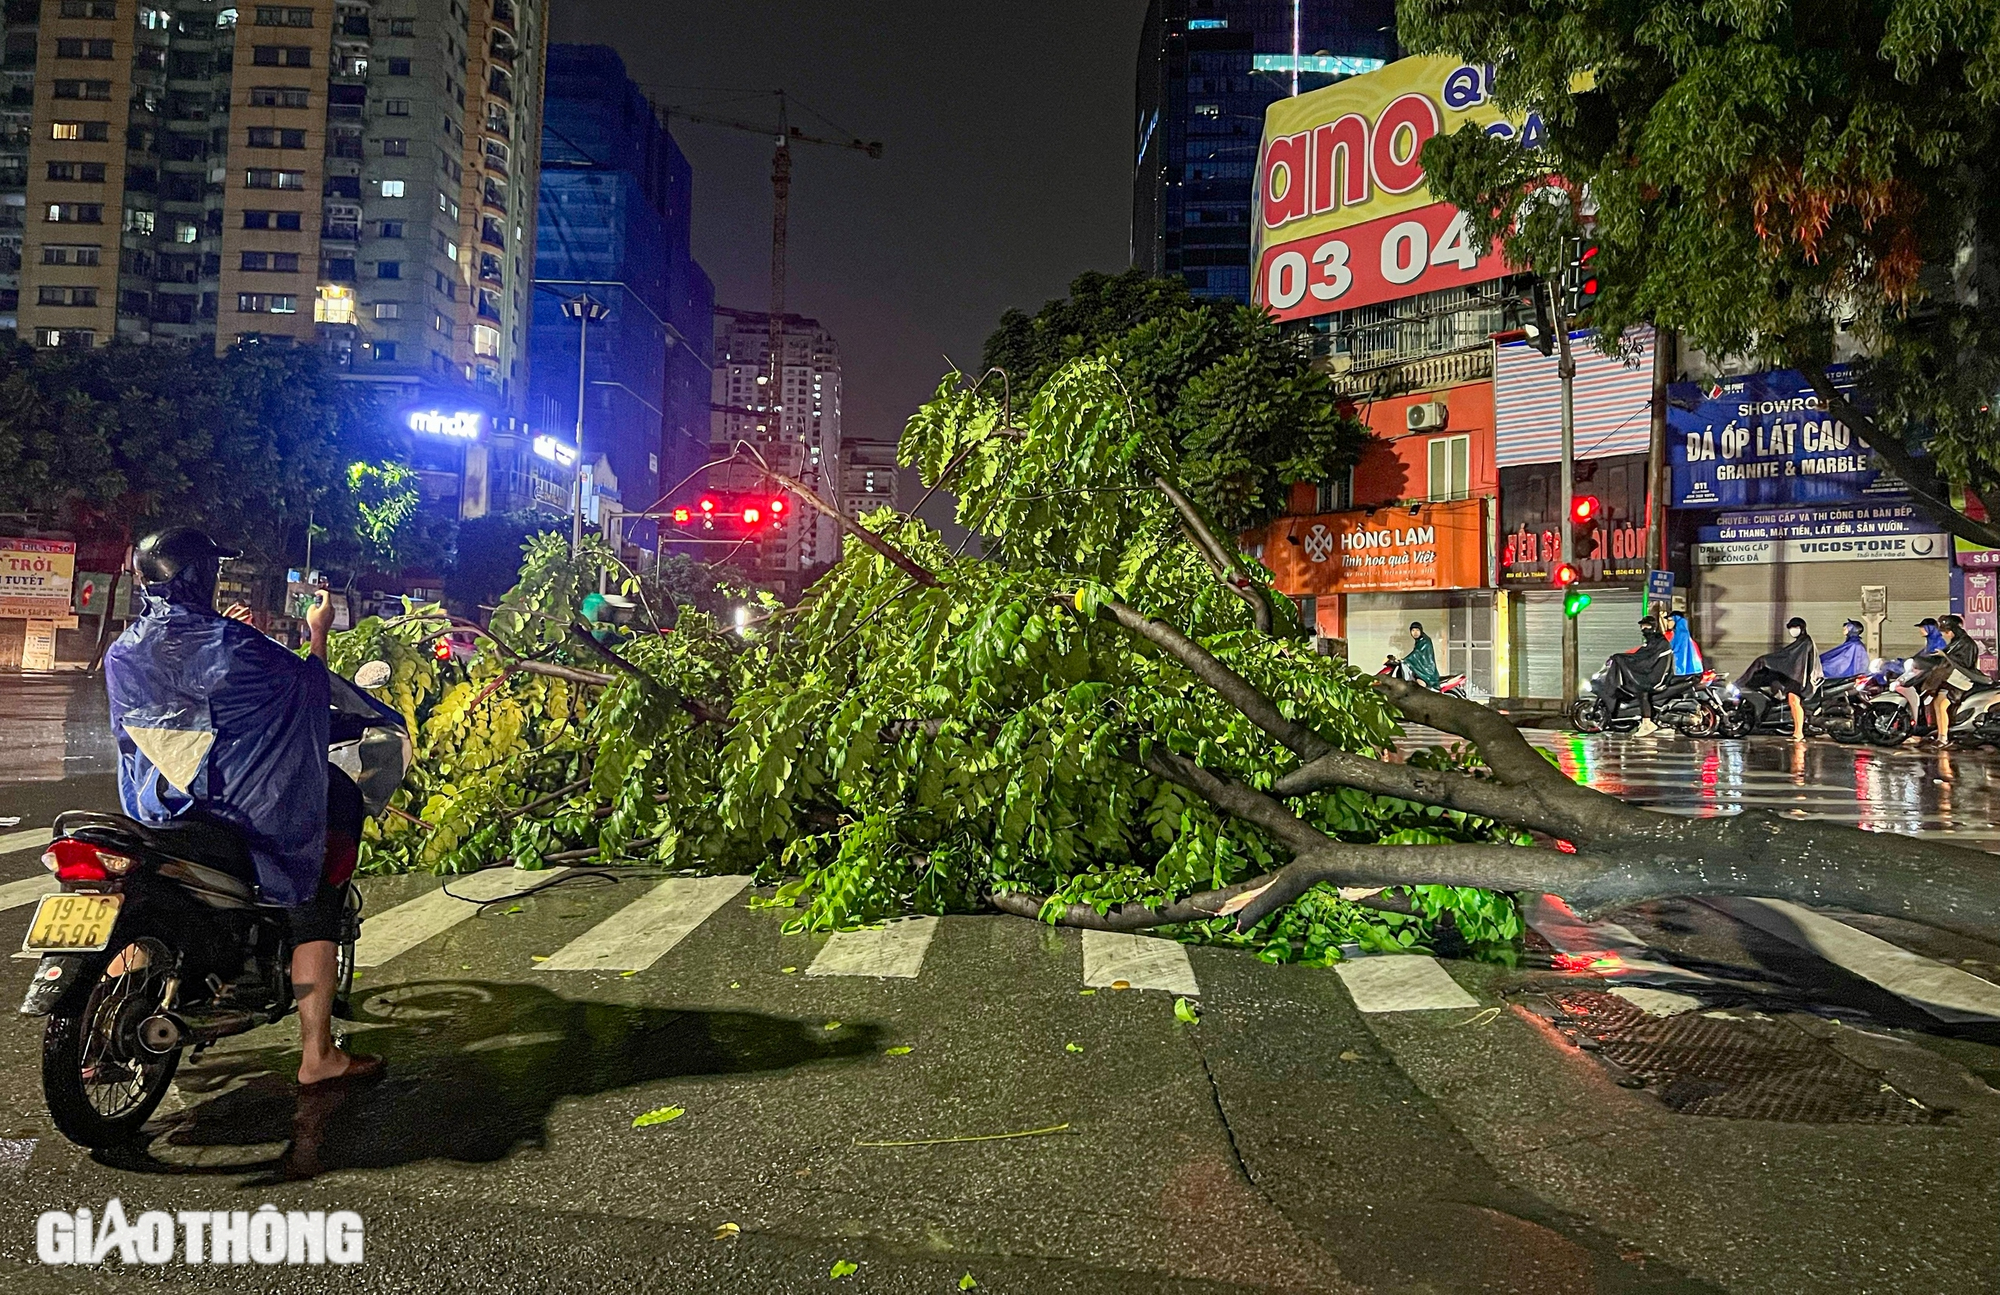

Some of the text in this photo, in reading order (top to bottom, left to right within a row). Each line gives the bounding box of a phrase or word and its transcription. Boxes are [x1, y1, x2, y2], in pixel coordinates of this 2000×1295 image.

[1268, 212, 1478, 309] 03 04
[1738, 392, 1842, 416] SHOWRO
[1686, 424, 1716, 462] ĐÁ
[1721, 420, 1750, 459] ỐP
[1756, 418, 1797, 456] LÁT
[1803, 419, 1850, 452] CAO
[1716, 455, 1867, 481] GRANITE & MARBLE
[1753, 515, 1776, 524] CUNG
[1778, 511, 1796, 523] CẤP
[1813, 512, 1827, 521] THI
[1830, 508, 1854, 519] CÔNG
[1857, 508, 1870, 519] ĐÁ
[1873, 507, 1892, 517] BÀN
[1341, 522, 1435, 550] HỒNG LAM
[1738, 528, 1768, 539] THANG,
[1815, 523, 1831, 535] LÁT
[1857, 521, 1875, 533] SÂN
[1727, 544, 1750, 553] CUNG
[1747, 553, 1759, 562] ĐÁ
[1800, 539, 1906, 553] VICOSTONE
[1365, 553, 1385, 566] hoa
[1388, 550, 1410, 566] quà
[1413, 550, 1436, 566] Việt
[51, 898, 110, 921] 19-L6
[37, 923, 101, 946] 1596
